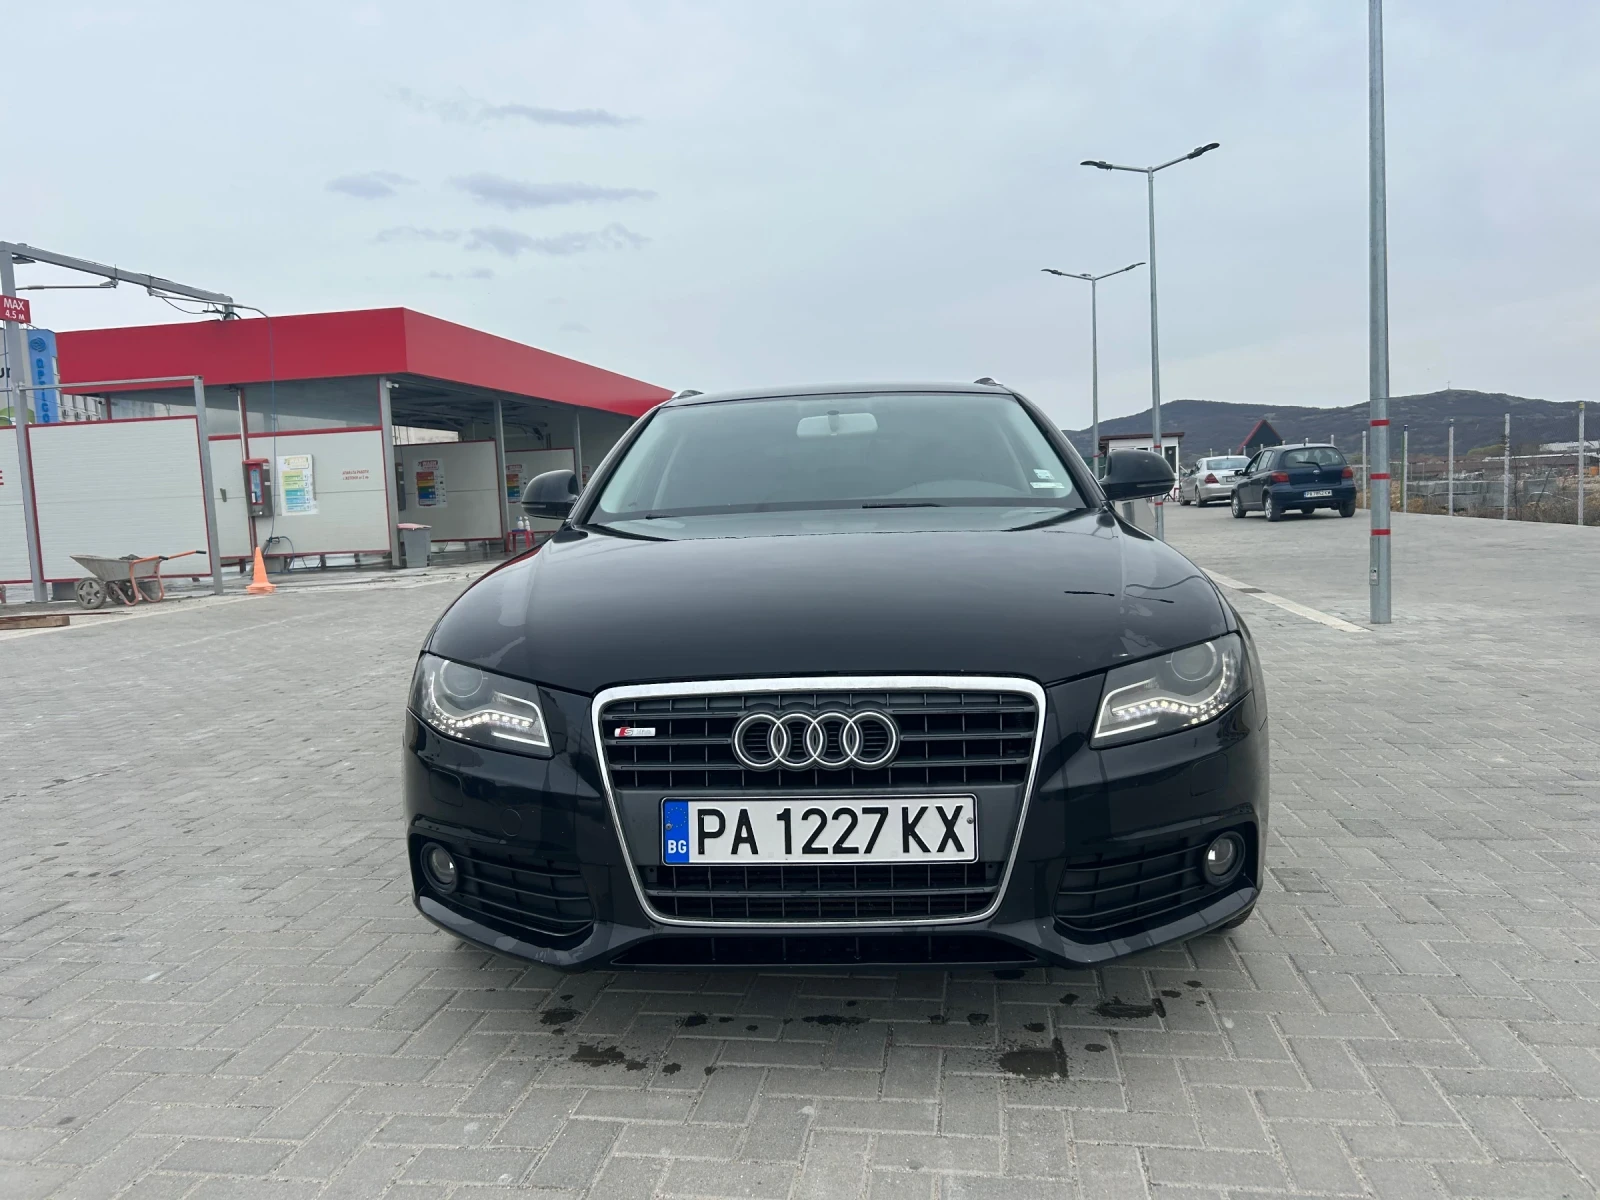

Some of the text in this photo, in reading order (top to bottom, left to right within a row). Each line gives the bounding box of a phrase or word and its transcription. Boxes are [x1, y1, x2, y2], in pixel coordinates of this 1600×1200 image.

[4, 298, 24, 311] MAX
[697, 805, 965, 855] PA 1227 KX
[667, 839, 687, 854] BG
